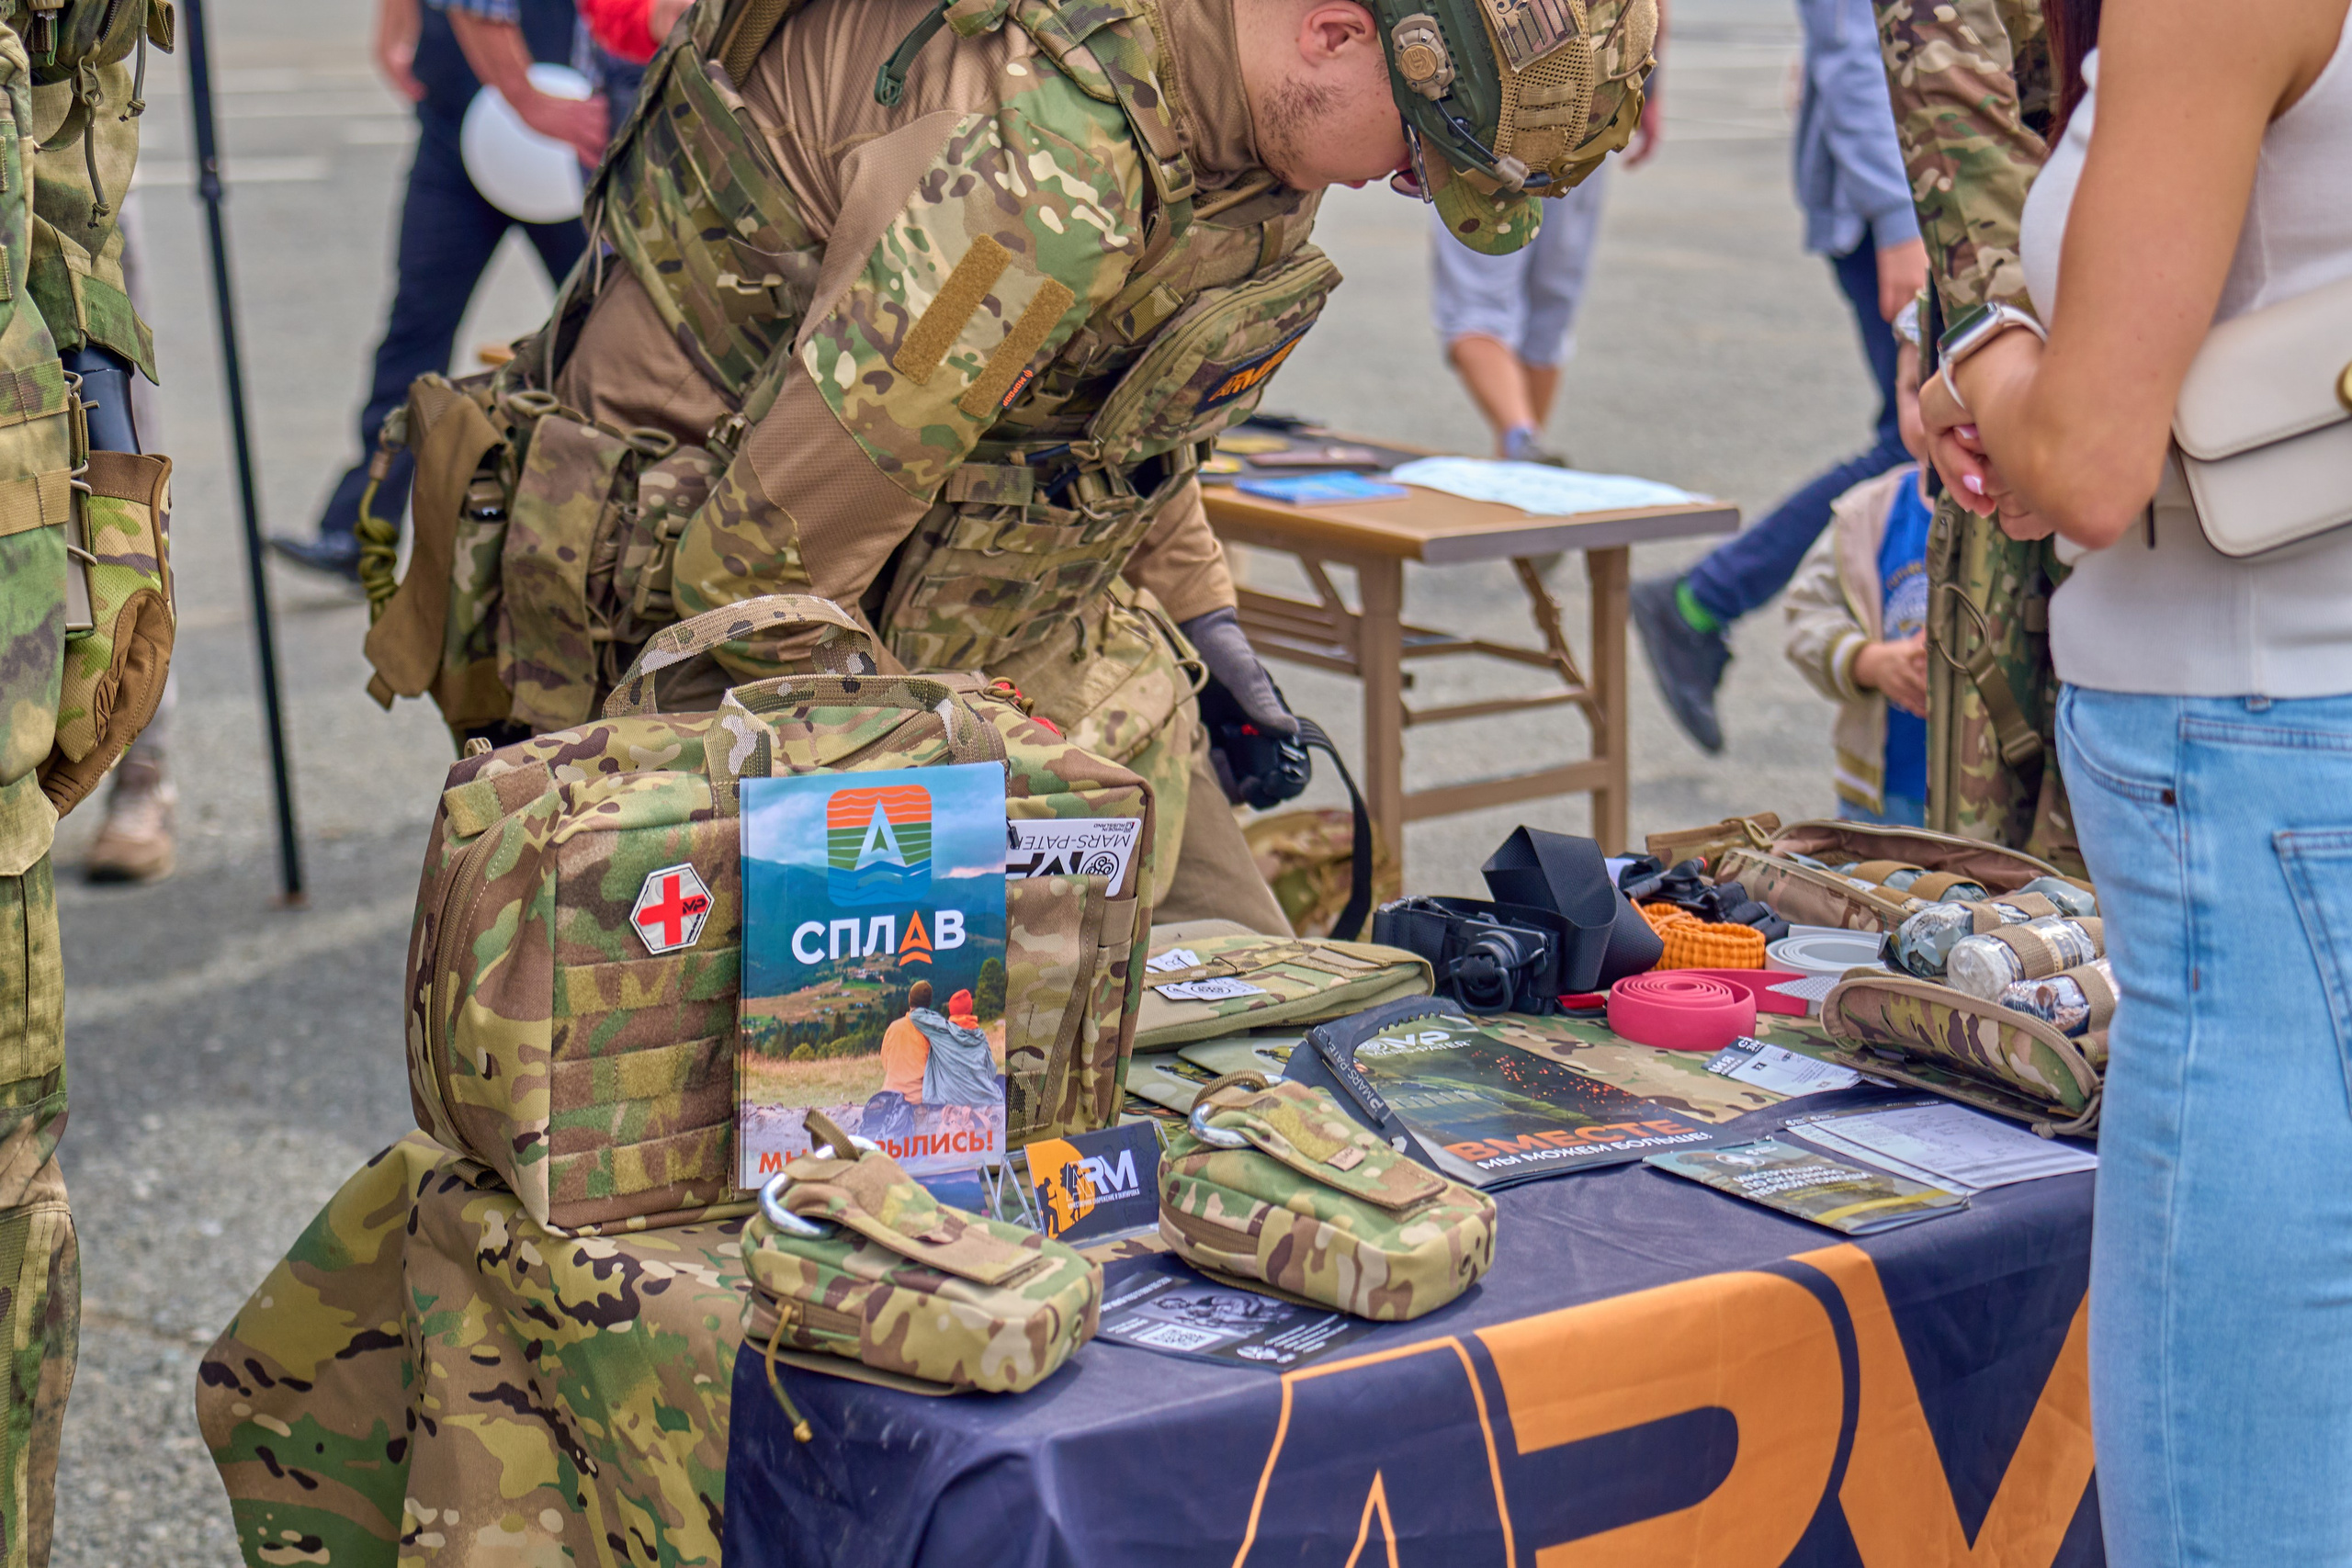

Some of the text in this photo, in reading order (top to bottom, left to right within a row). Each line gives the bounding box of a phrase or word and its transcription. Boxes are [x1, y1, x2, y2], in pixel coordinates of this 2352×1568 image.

[791, 909, 967, 967] СПЛАВ
[1442, 1119, 1697, 1162] ВМЕСТЕ
[1476, 1152, 1522, 1170] МЫ
[1519, 1145, 1612, 1162] МОЖЕМ
[1066, 1149, 1139, 1202] ARM
